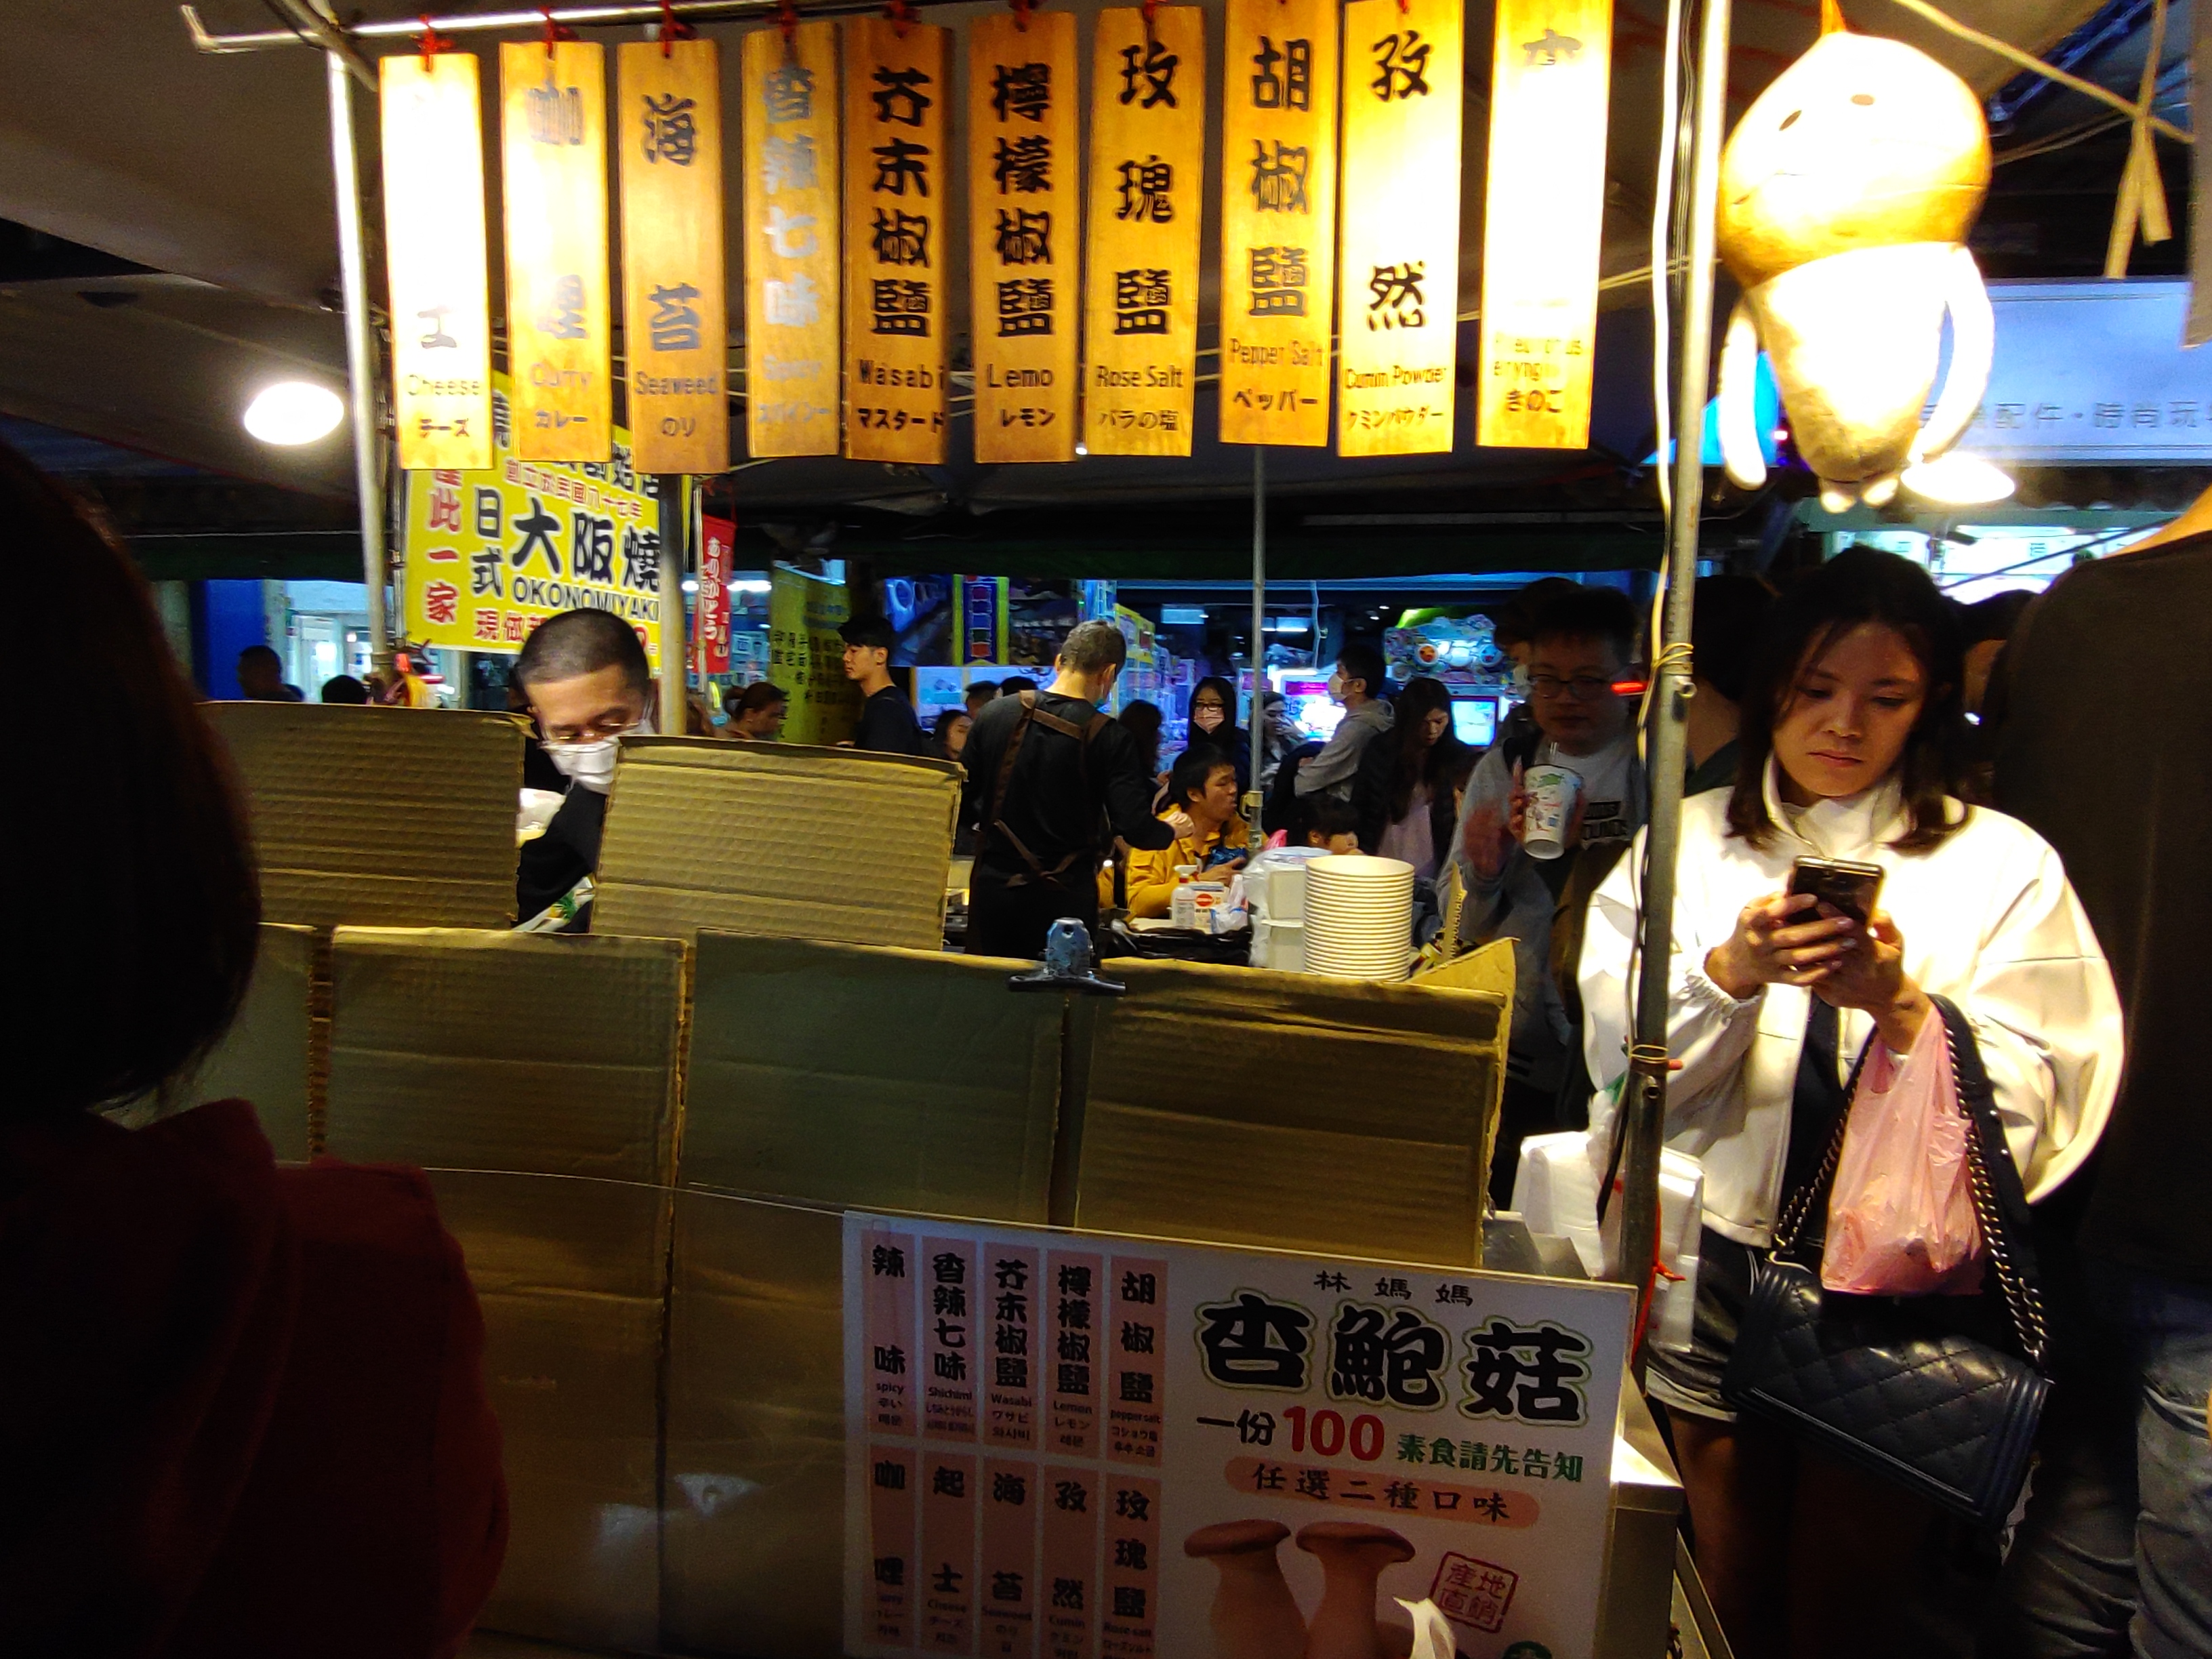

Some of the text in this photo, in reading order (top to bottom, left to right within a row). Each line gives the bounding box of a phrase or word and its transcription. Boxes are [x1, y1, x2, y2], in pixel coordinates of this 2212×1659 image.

[642, 92, 701, 352] 海苔
[872, 66, 933, 338] 芥末椒鹽
[992, 62, 1054, 337] 檸檬椒鹽
[1114, 41, 1179, 335] 玫瑰鹽
[1248, 35, 1312, 317] 胡椒鹽
[1367, 30, 1431, 331] 孜然
[859, 359, 945, 389] Wasabi
[1095, 365, 1184, 388] Rose Salt
[1229, 338, 1285, 365] Pepper
[1232, 388, 1319, 412] ペッパー
[1506, 388, 1563, 413] きのこ
[659, 417, 696, 437] のり
[857, 407, 945, 434] マスタード
[1001, 408, 1056, 427] レモン
[1098, 409, 1179, 431] バラの塩
[470, 488, 503, 598] 日式
[511, 496, 661, 594] 大阪燒
[872, 1244, 905, 1374] 辣味
[933, 1252, 966, 1381] 香辣七味
[994, 1258, 1028, 1388] 芥末椒鹽
[1057, 1264, 1091, 1395] 檸檬椒鹽
[1120, 1271, 1156, 1404] 胡椒鹽
[1314, 1269, 1473, 1308] 林媽媽
[991, 1393, 1032, 1407] Wasabi
[1053, 1400, 1092, 1414] Lemon
[1200, 1289, 1588, 1425] 杏鮑菇
[992, 1410, 1029, 1424] ワサビ
[1054, 1417, 1089, 1430] レモン
[1196, 1406, 1385, 1461] 一份 100
[1395, 1433, 1584, 1483] 素食請先告知
[874, 1460, 905, 1586] 咖哩
[932, 1466, 965, 1594] 起士
[993, 1472, 1025, 1601] 海苔
[1252, 1463, 1510, 1523] 任選二種口味
[1052, 1481, 1087, 1610] 孜然
[1113, 1489, 1151, 1619] 玫瑰鹽
